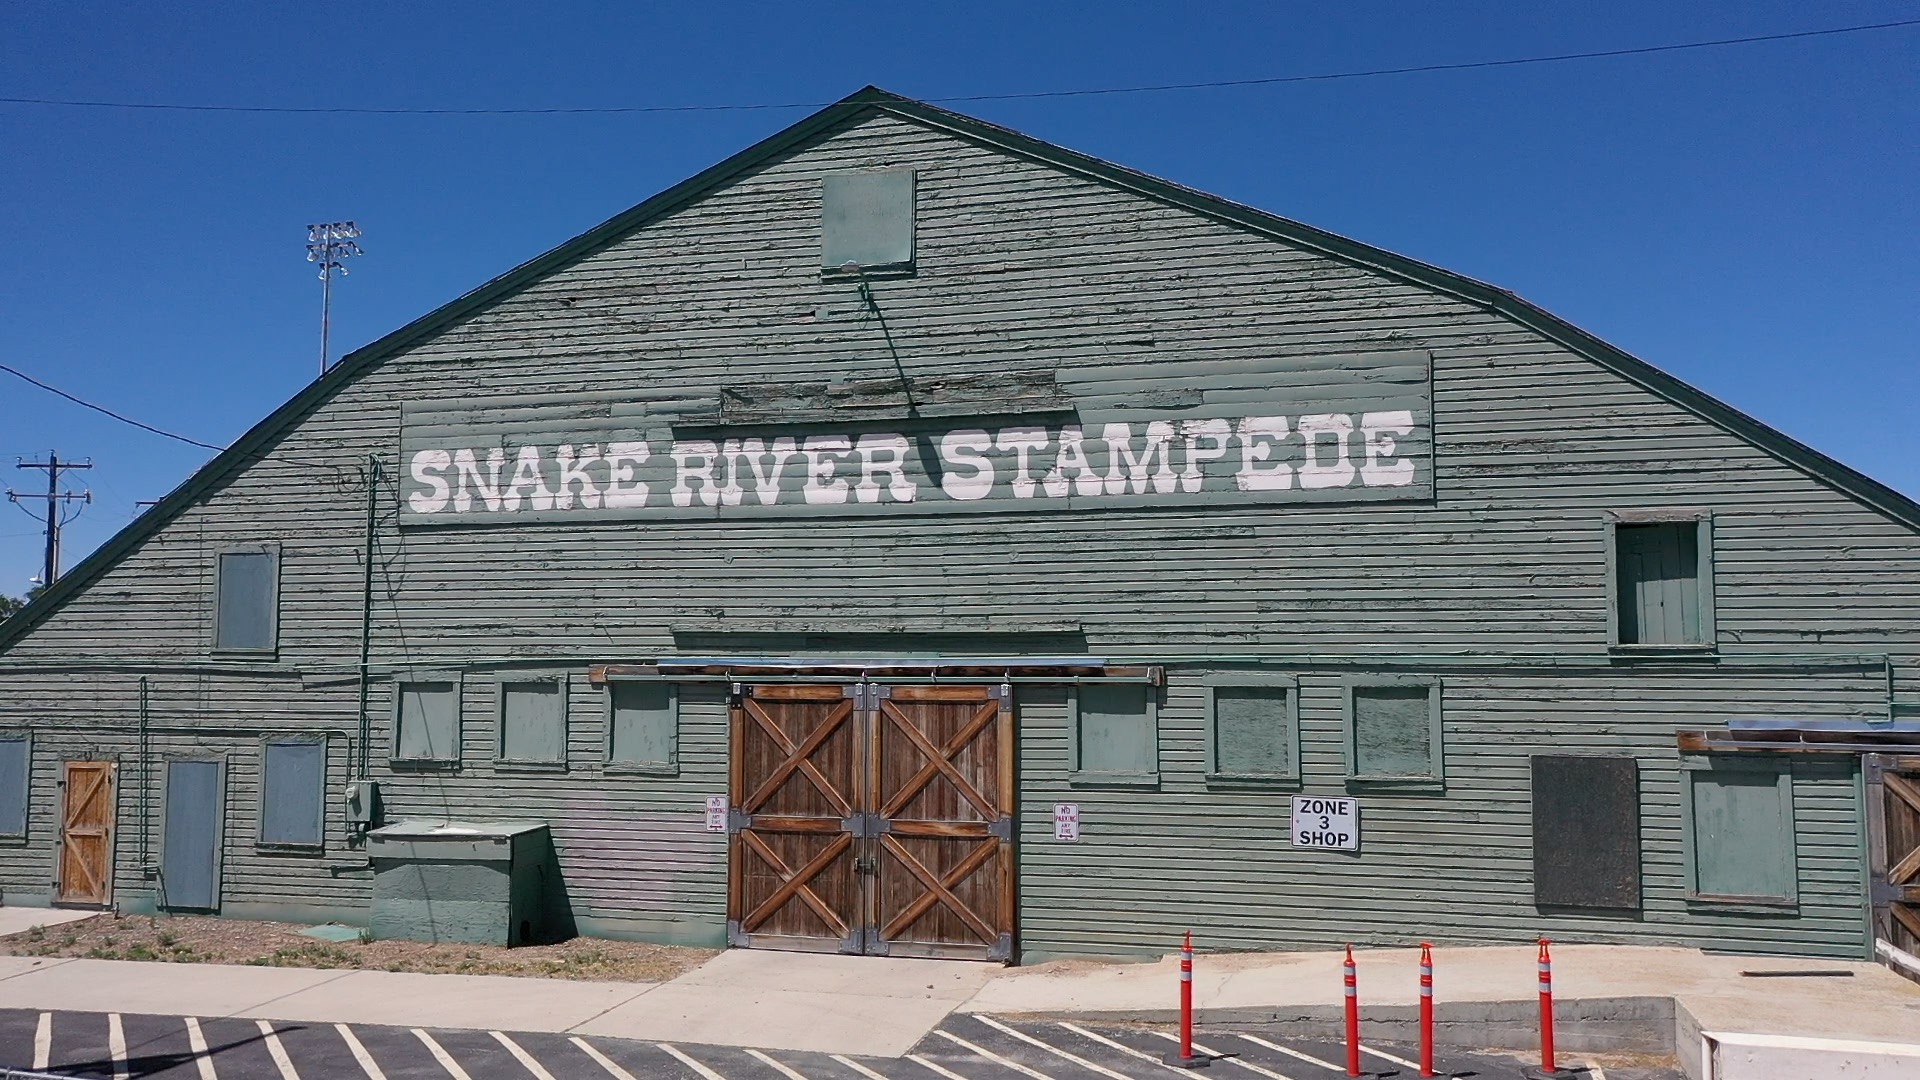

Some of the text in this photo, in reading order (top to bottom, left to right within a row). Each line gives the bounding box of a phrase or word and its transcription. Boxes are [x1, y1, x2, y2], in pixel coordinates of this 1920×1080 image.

[408, 410, 1416, 513] SNAKE RIVER STAMPEDE
[1300, 800, 1349, 816] ZONE
[1318, 816, 1330, 830] 3
[1300, 830, 1349, 847] SHOP
